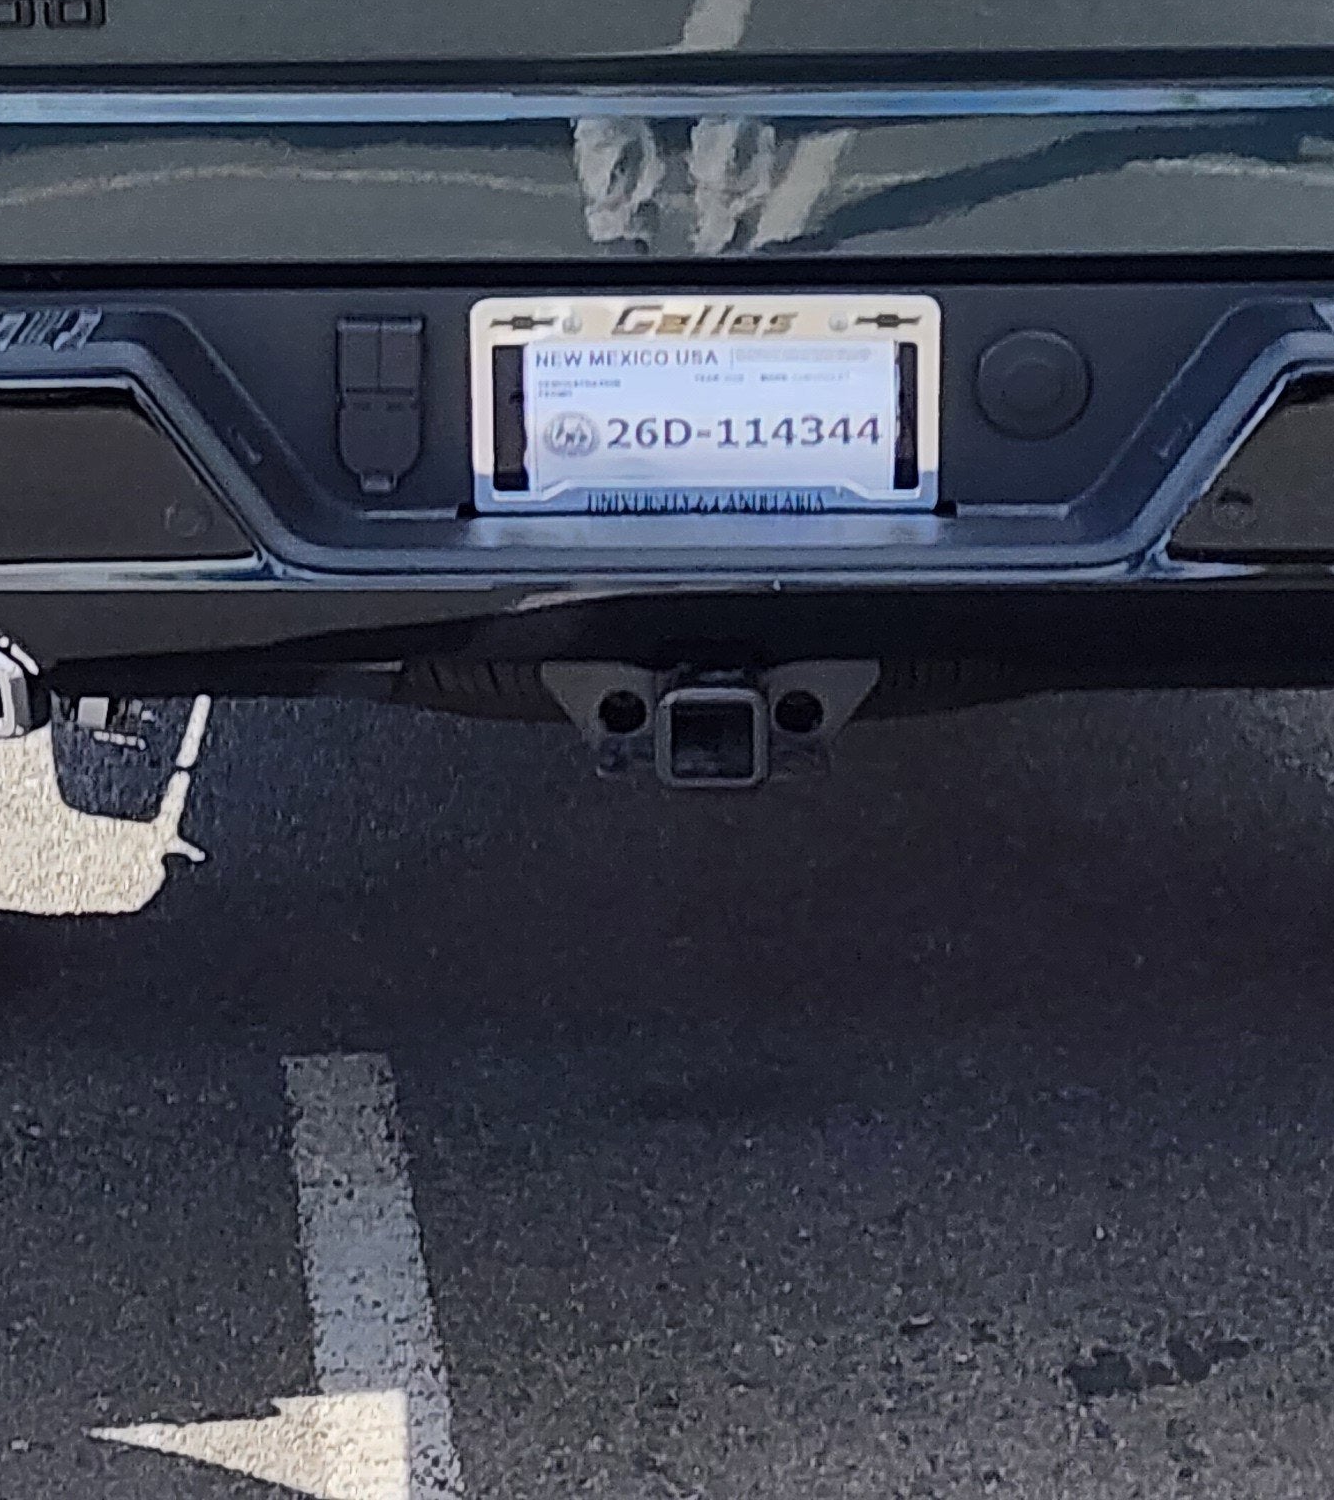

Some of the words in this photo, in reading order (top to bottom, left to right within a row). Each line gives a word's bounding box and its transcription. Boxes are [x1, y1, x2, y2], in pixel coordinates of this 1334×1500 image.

[611, 305, 798, 336] Galles
[535, 350, 582, 367] NEW
[589, 350, 669, 367] MEXICO
[675, 350, 719, 367] USA
[607, 415, 883, 449] 26D-114344
